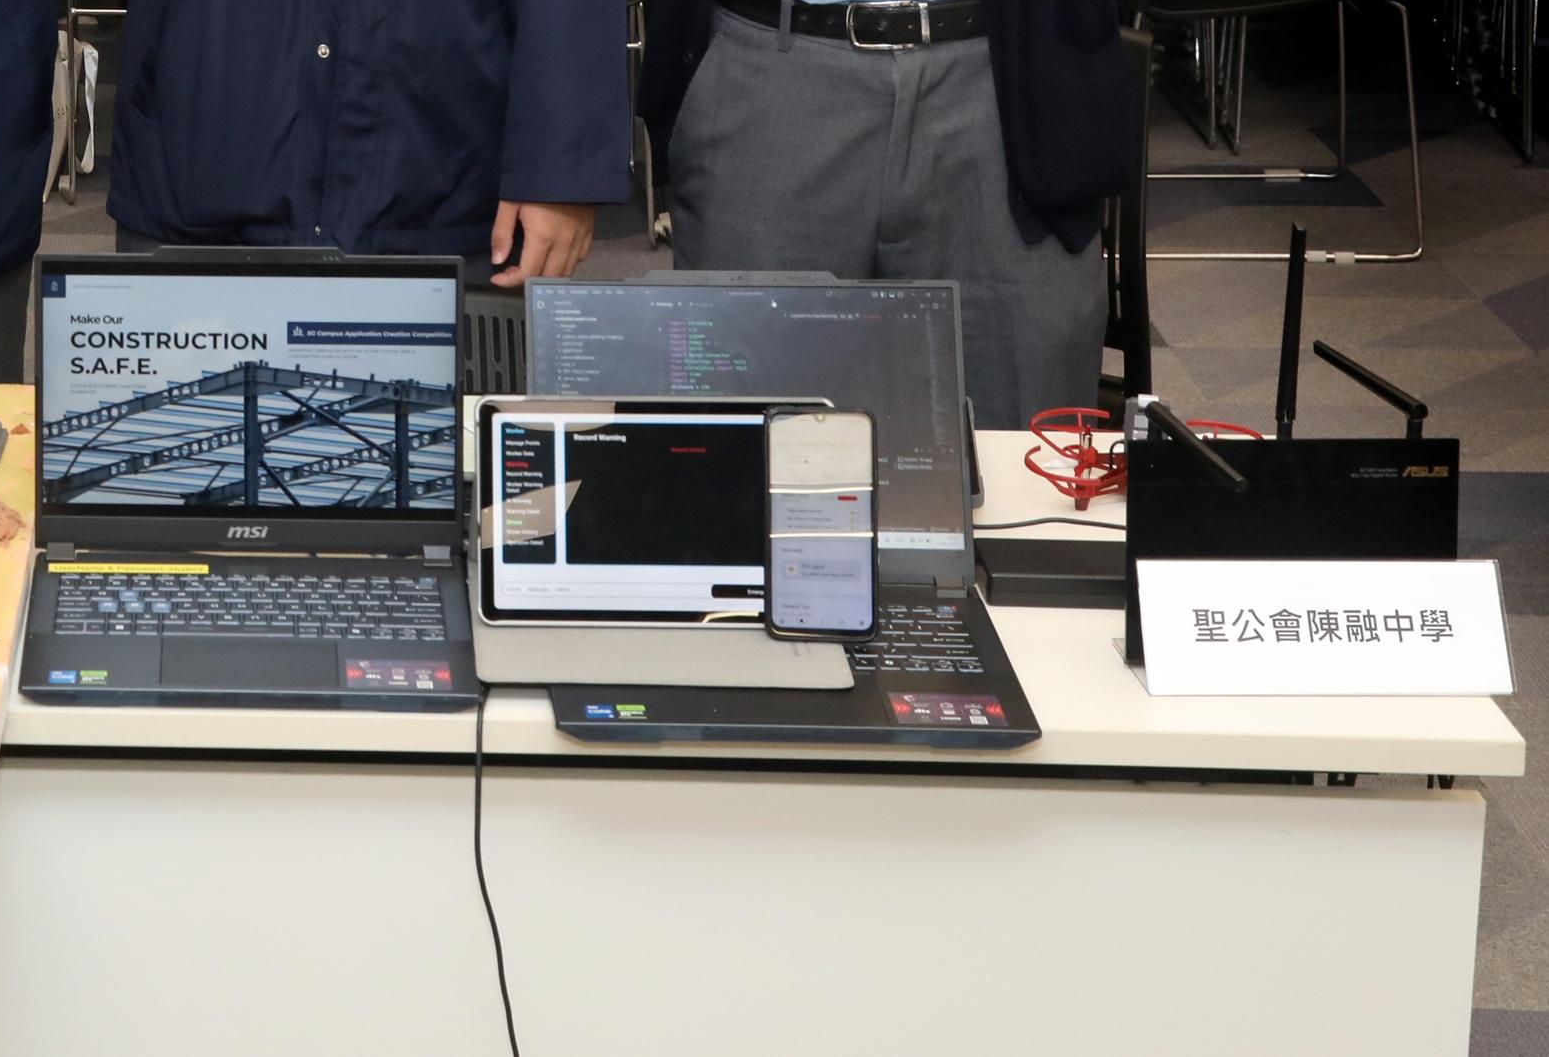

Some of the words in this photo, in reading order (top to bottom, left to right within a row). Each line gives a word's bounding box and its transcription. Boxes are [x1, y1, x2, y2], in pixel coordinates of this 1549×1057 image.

[70, 314, 101, 325] Make
[102, 314, 124, 325] Our
[70, 330, 268, 351] CONSTRUCTION
[70, 356, 158, 375] S.A.F.E.
[598, 433, 627, 444] Warning
[1402, 465, 1449, 478] ASUS
[226, 526, 269, 539] msi
[1192, 607, 1455, 644] 聖公會陳融中學
